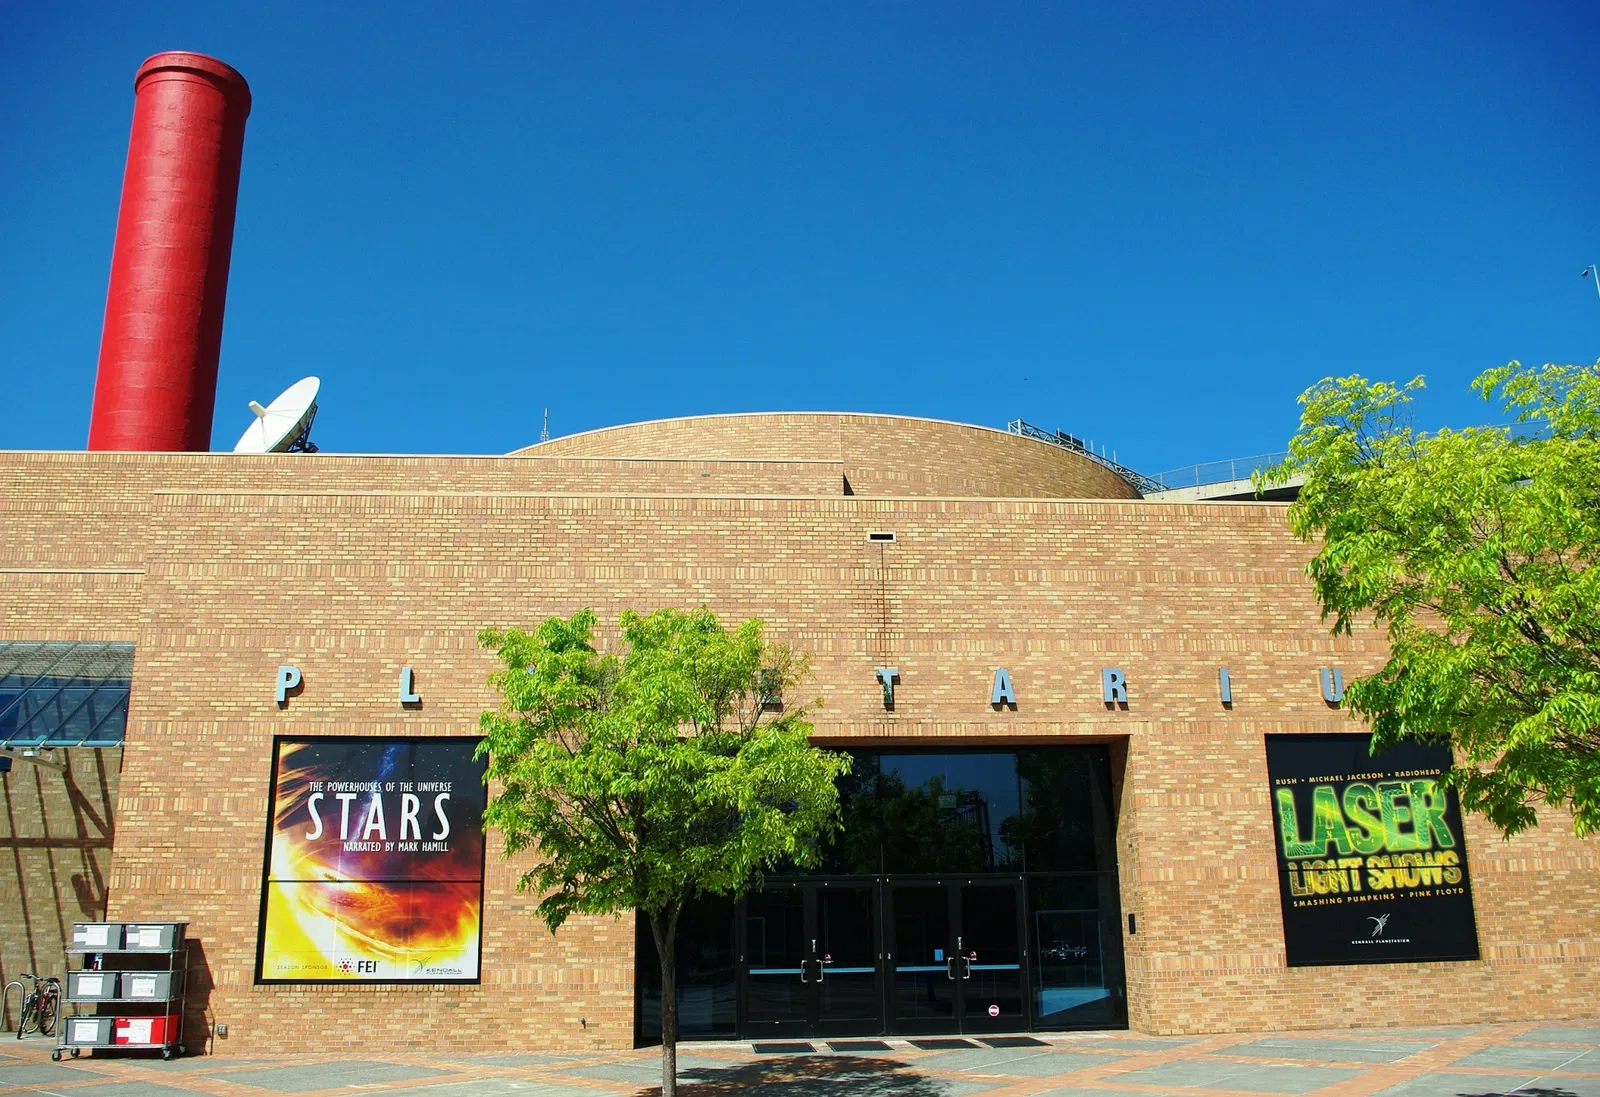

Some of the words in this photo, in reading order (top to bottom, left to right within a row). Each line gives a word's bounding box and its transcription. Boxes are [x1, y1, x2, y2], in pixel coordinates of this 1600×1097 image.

[1275, 778, 1297, 786] RUSH
[1308, 775, 1343, 783] MICHAEL
[1346, 772, 1384, 781] JACKSON
[1395, 768, 1441, 777] RADIOHEAD
[309, 782, 323, 792] THE
[327, 782, 382, 793] POWERHOUSES
[386, 782, 396, 791] OF
[400, 782, 413, 791] THE
[418, 782, 452, 792] UNIVERSE
[305, 793, 451, 840] STARS
[1276, 780, 1455, 858] LASER
[343, 842, 381, 852] NARRATED
[385, 842, 395, 852] BY
[398, 842, 418, 852] MARK
[422, 842, 449, 852] HAMILL
[1288, 857, 1363, 896] LIGHT
[1367, 850, 1462, 890] SHOWS
[1293, 897, 1343, 907] SMASHING
[1347, 893, 1395, 903] PUMPKINS
[1409, 890, 1432, 898] PINK
[1436, 887, 1464, 896] FLOYD
